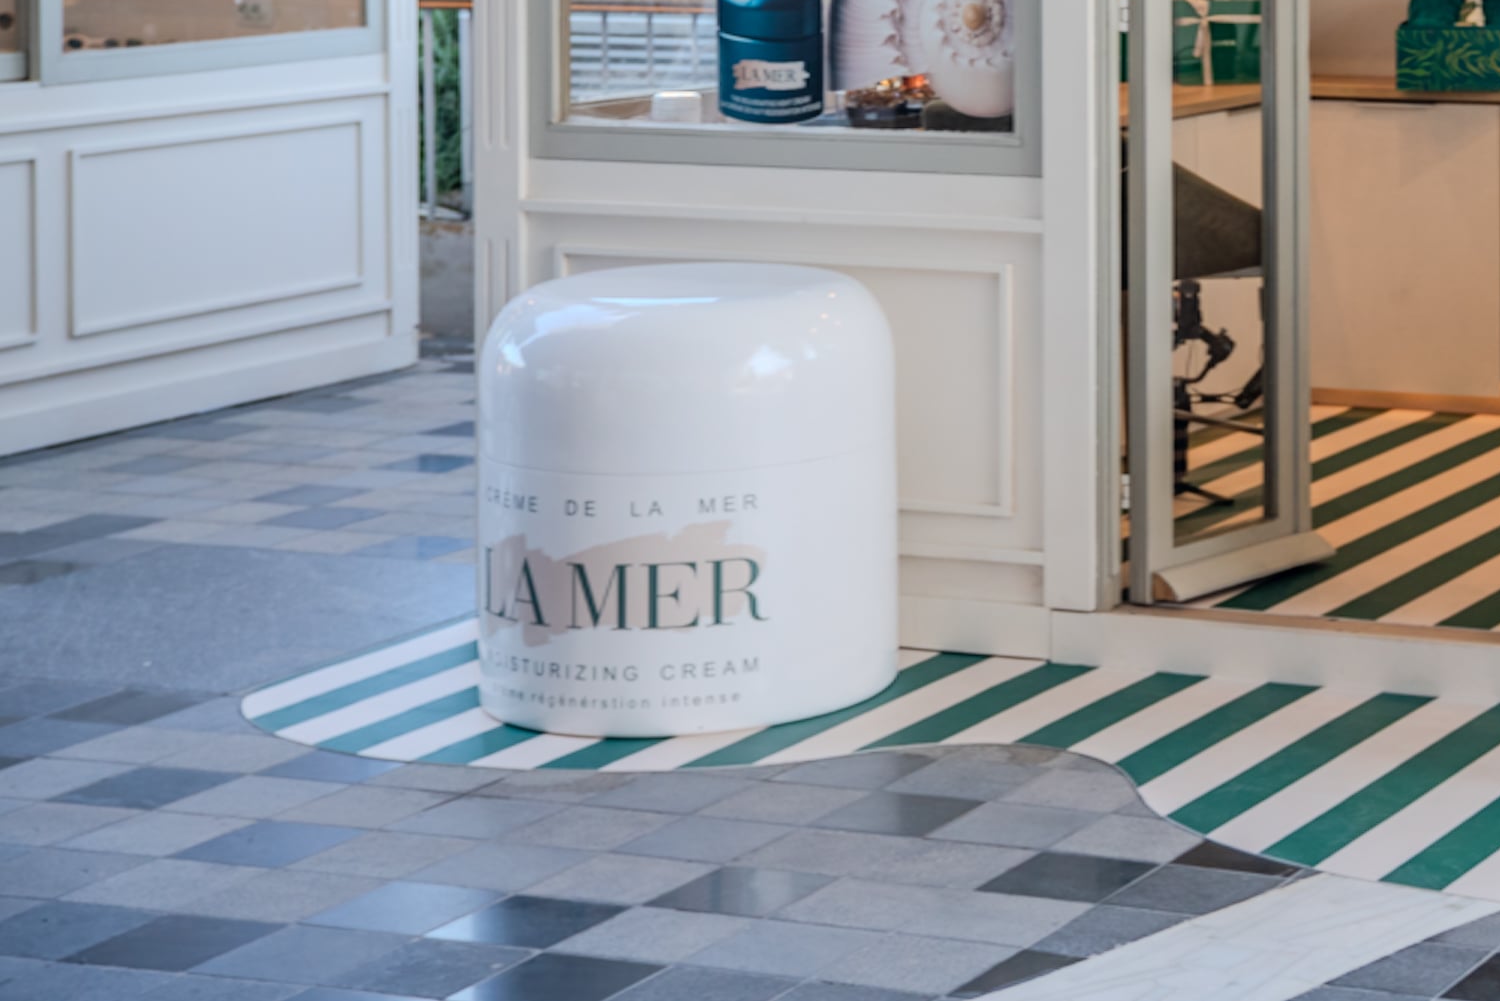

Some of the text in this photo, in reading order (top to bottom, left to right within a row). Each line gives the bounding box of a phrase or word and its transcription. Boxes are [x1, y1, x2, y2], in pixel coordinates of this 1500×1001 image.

[564, 499, 596, 517] DE
[629, 500, 664, 518] LA
[698, 493, 758, 514] MER
[566, 557, 770, 631] MER
[659, 656, 759, 681] CREAM
